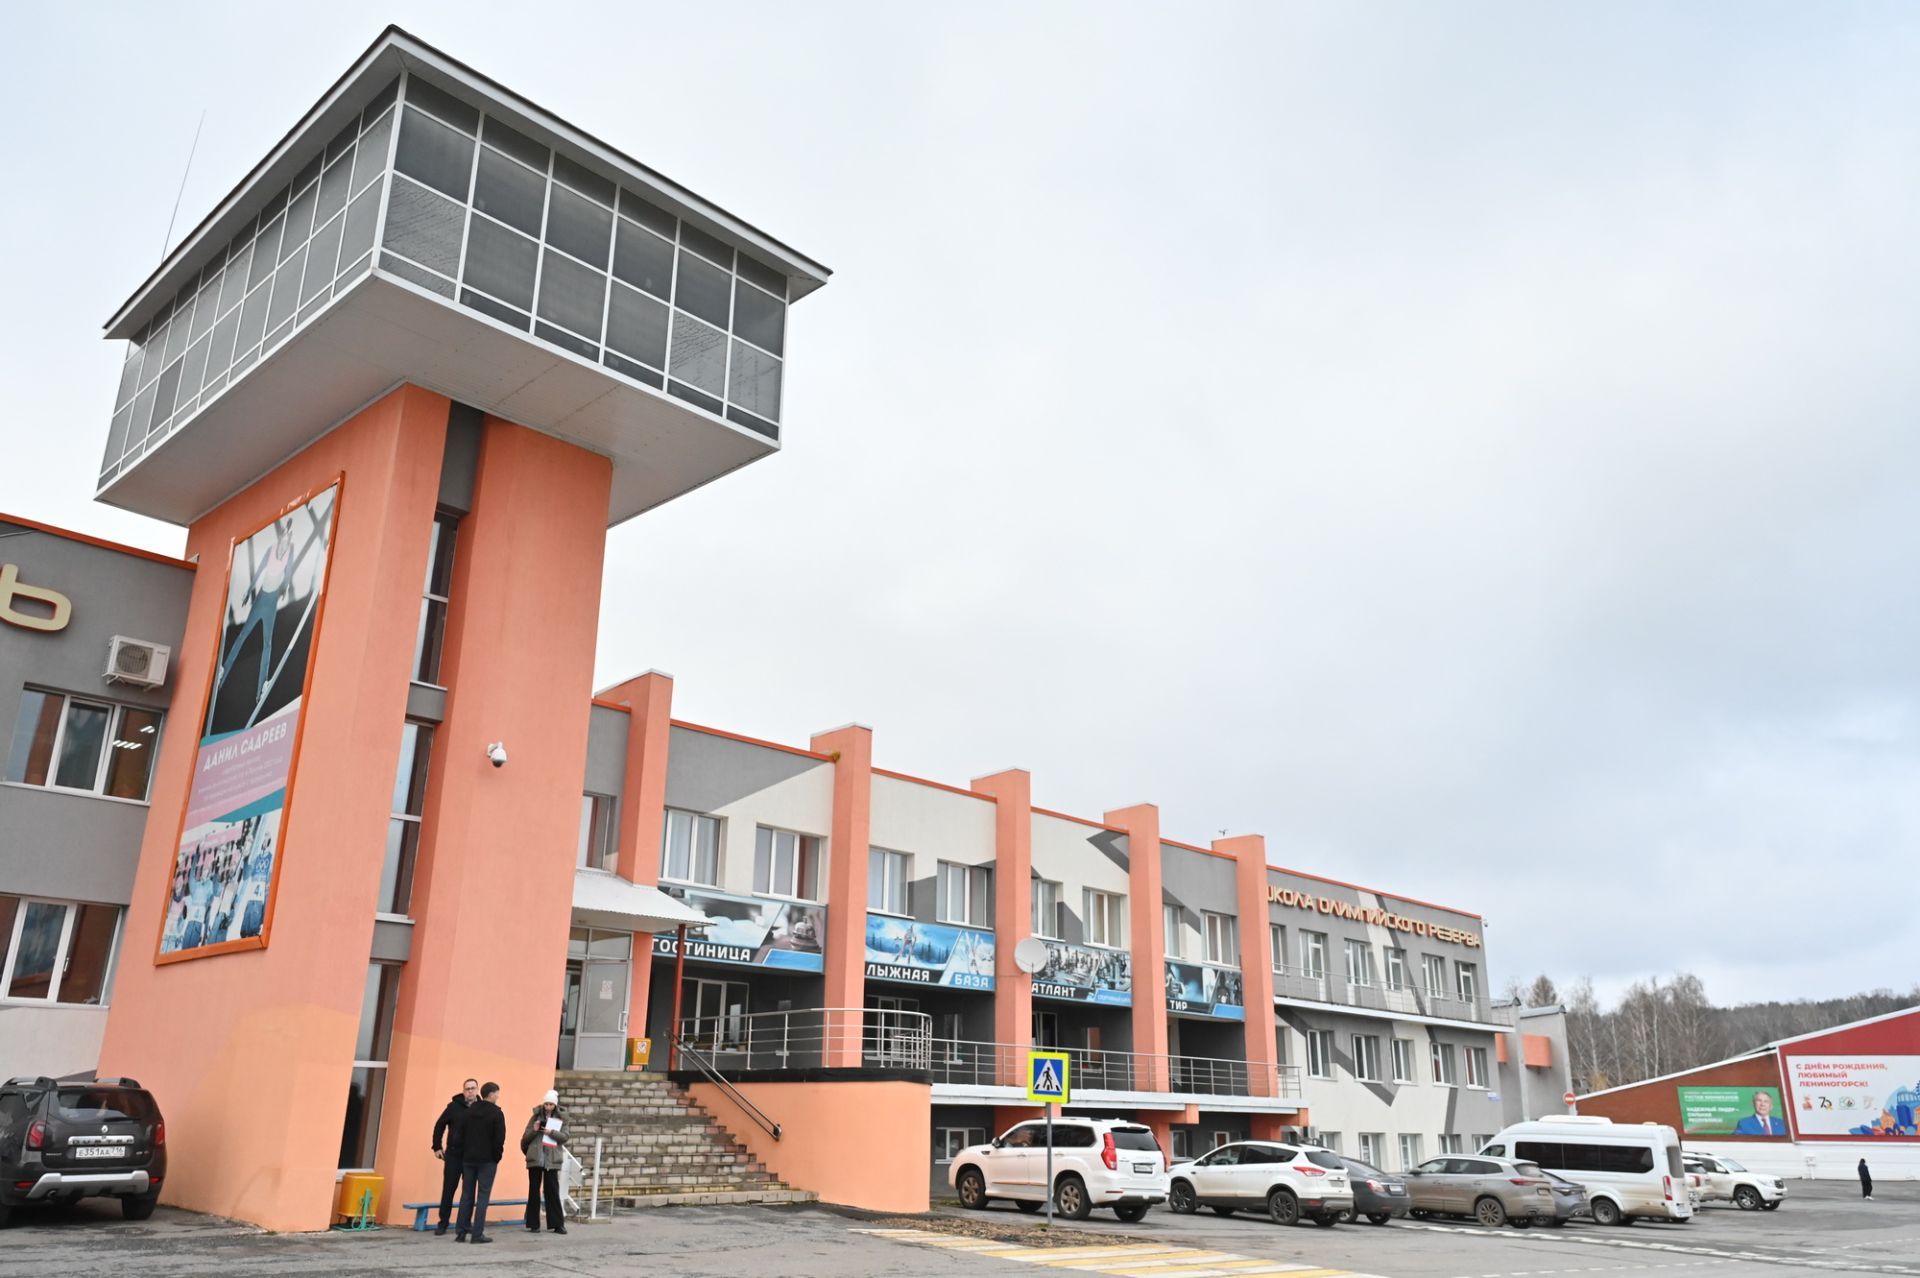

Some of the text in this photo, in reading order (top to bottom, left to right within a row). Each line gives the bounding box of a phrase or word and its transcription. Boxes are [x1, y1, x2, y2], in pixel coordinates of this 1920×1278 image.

[203, 722, 287, 772] ДАНИЛ САДРЕЕВ
[1318, 897, 1426, 935] ОЛИМПИЙСКОГО
[1429, 923, 1480, 947] РЕЗЕРВА
[866, 964, 989, 988] ЛЫЖНАЯ БАЗА
[1031, 983, 1077, 998] АТЛАНТ
[1169, 1000, 1188, 1011] ТИР
[1798, 1071, 1848, 1079] ЛЮБИМЫЙ
